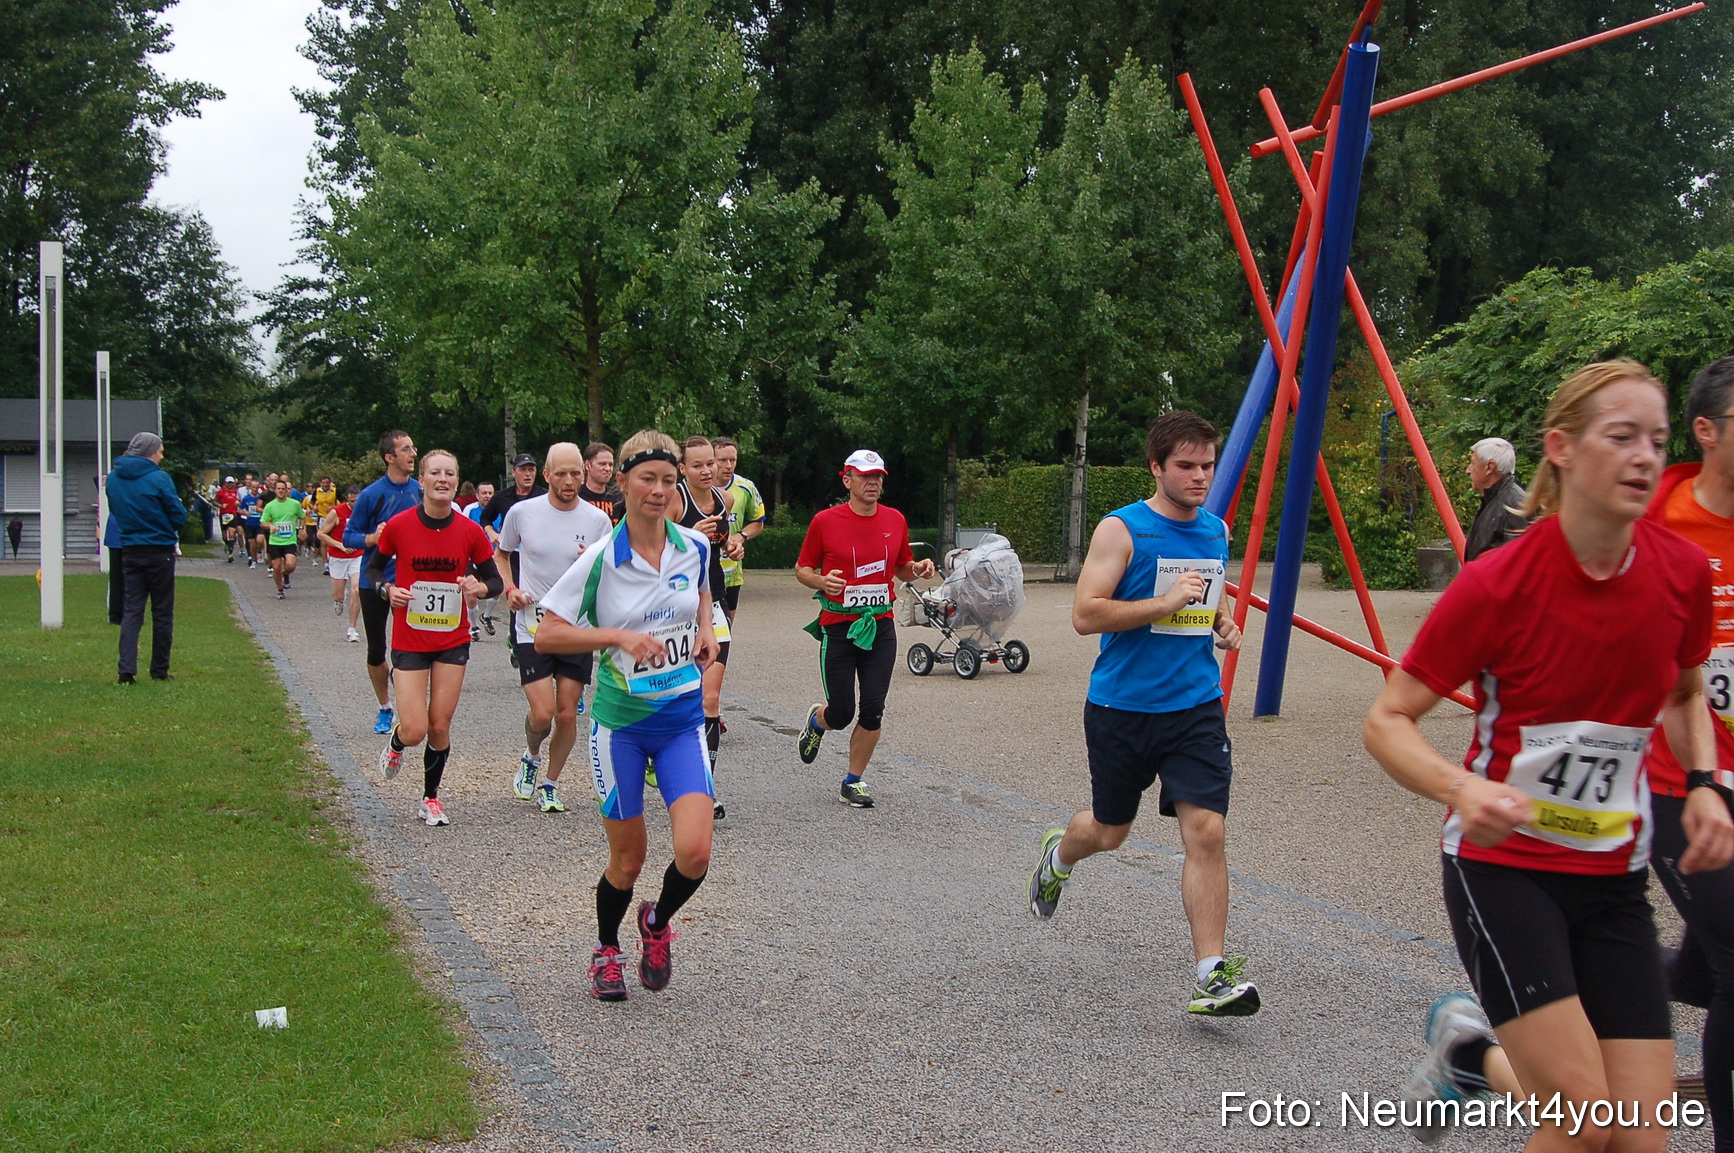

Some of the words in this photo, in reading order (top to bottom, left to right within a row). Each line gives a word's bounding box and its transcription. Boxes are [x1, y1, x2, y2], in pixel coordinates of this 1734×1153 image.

[1159, 566, 1182, 574] PARTL
[425, 594, 446, 613] 31
[420, 615, 449, 625] Vanessa
[644, 607, 675, 622] Heidi
[1170, 613, 1210, 625] Andreas
[1576, 733, 1631, 751] Neumarkt
[1537, 751, 1621, 804] 473
[1539, 806, 1600, 835] Ursula
